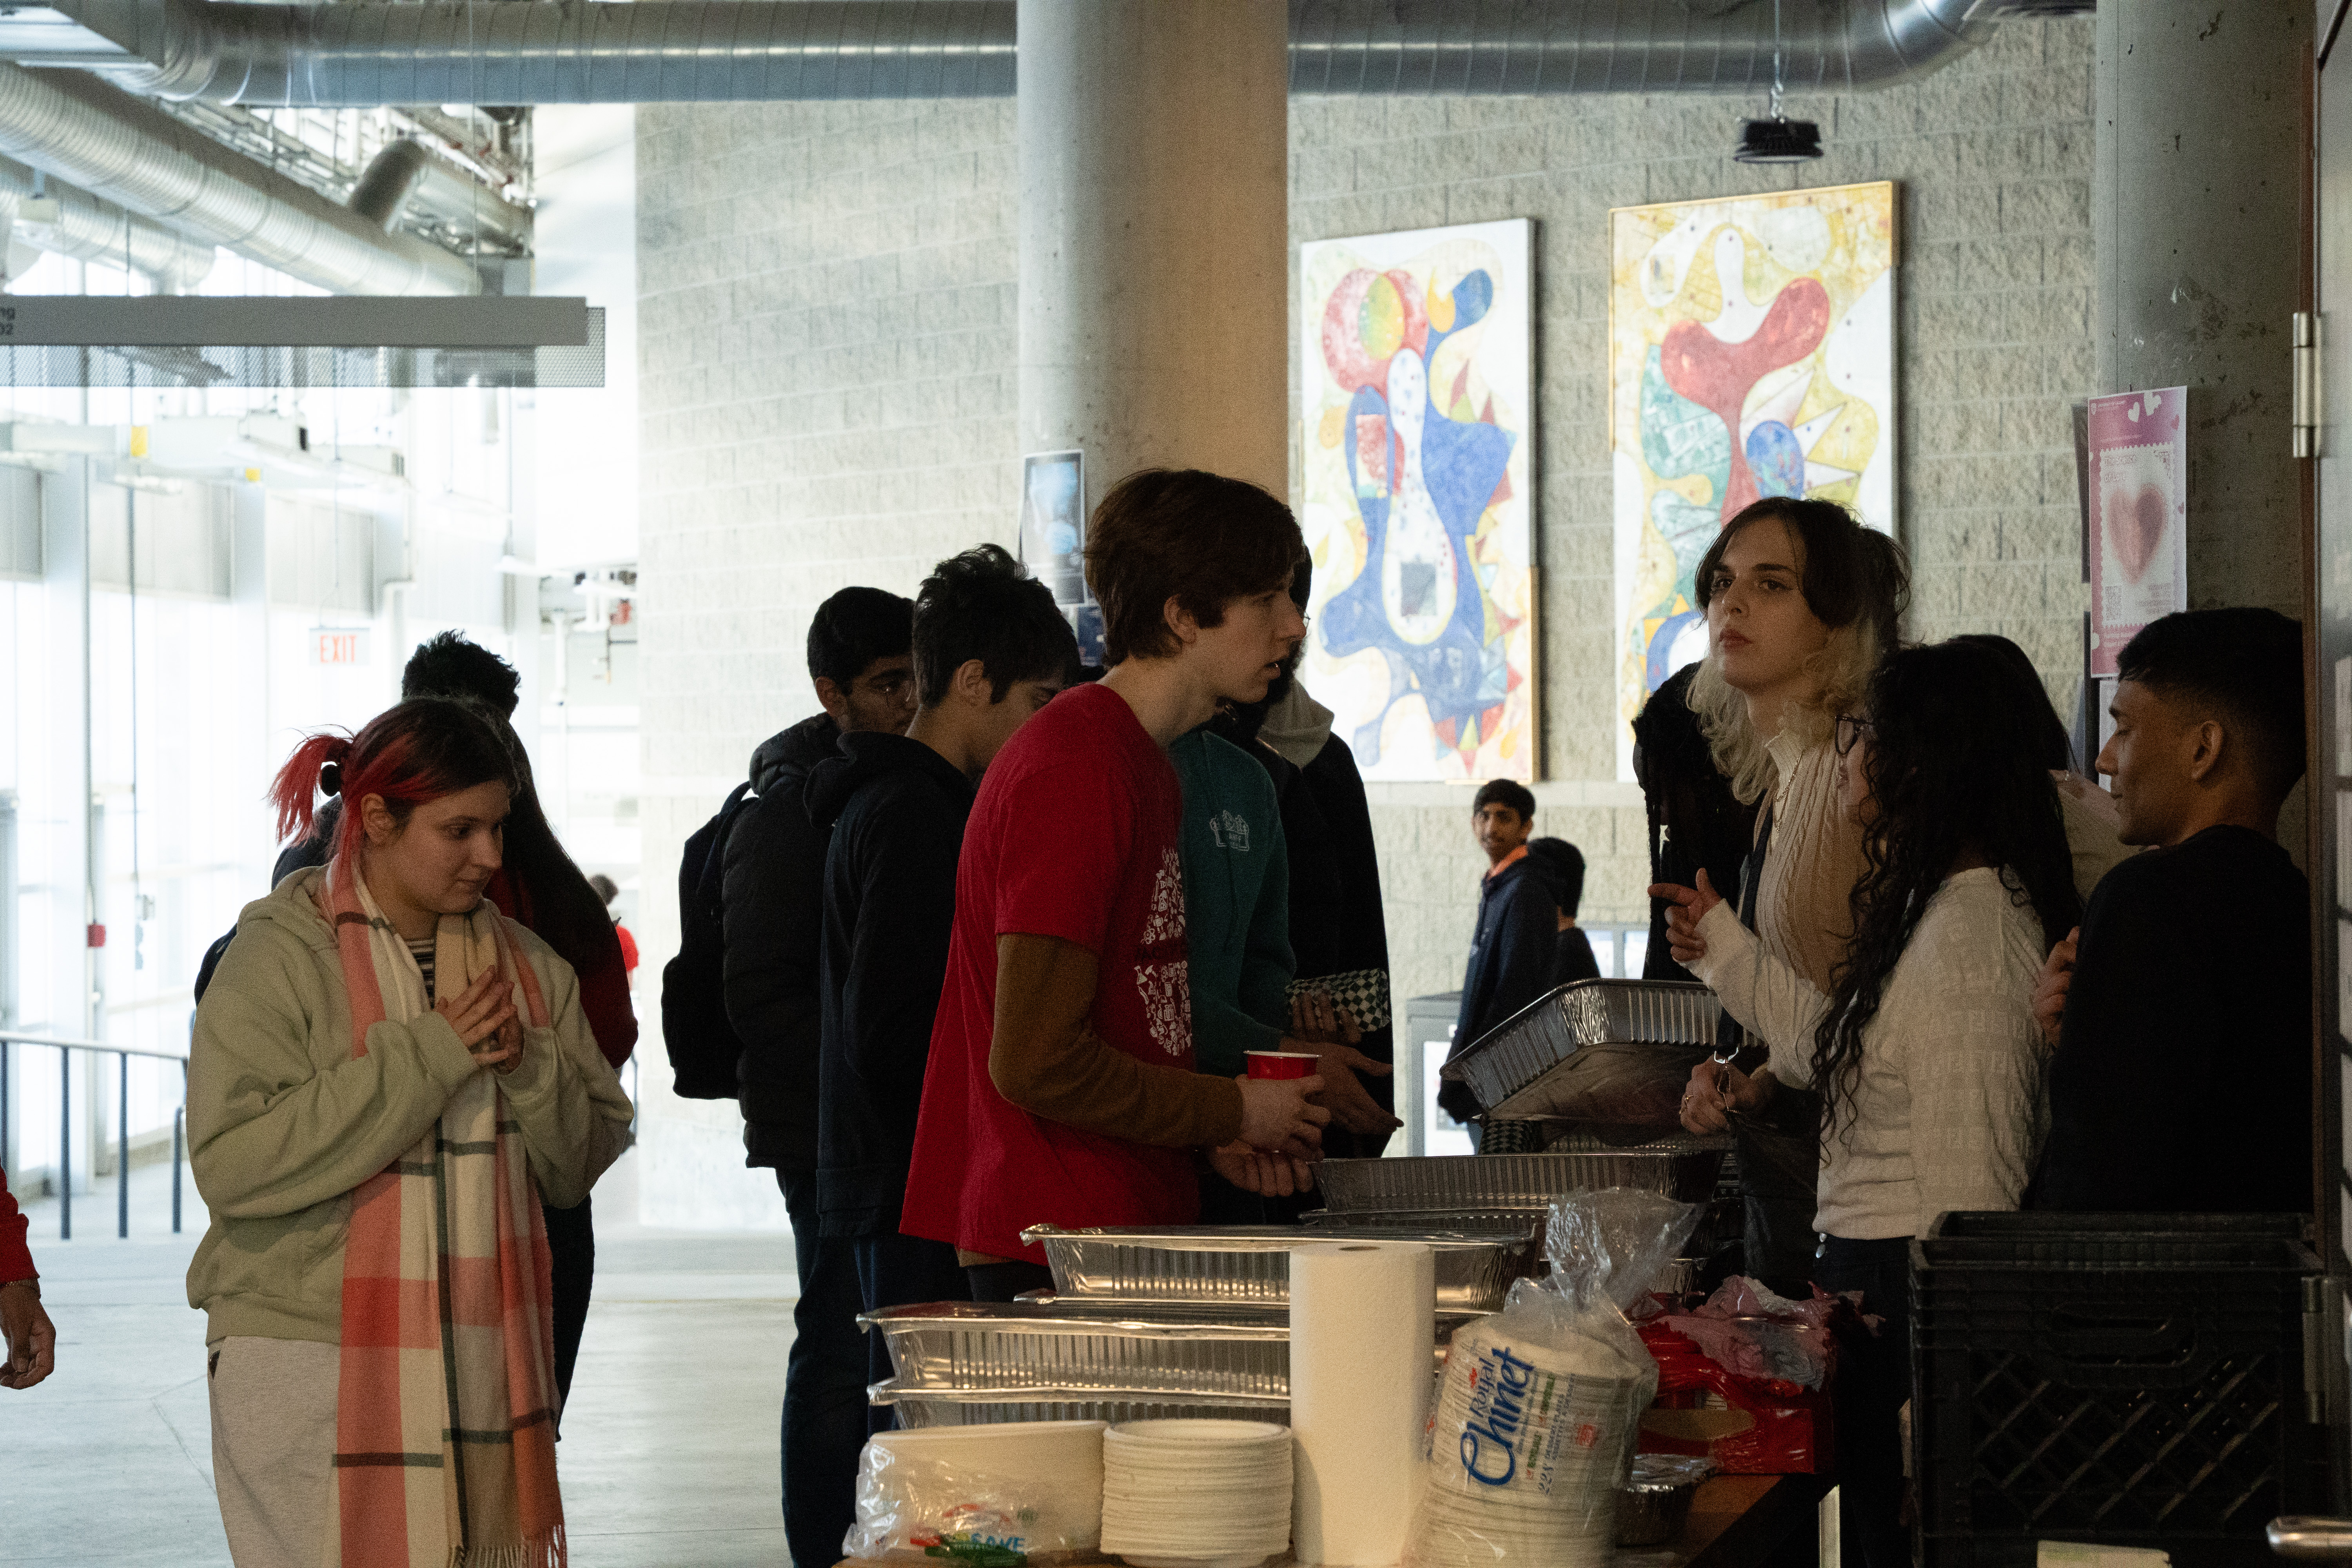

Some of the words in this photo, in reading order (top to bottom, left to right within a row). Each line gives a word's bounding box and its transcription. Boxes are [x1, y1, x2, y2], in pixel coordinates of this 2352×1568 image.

[320, 635, 357, 662] EXIT
[1460, 1347, 1534, 1486] Chinet
[1470, 1358, 1494, 1417] Royal
